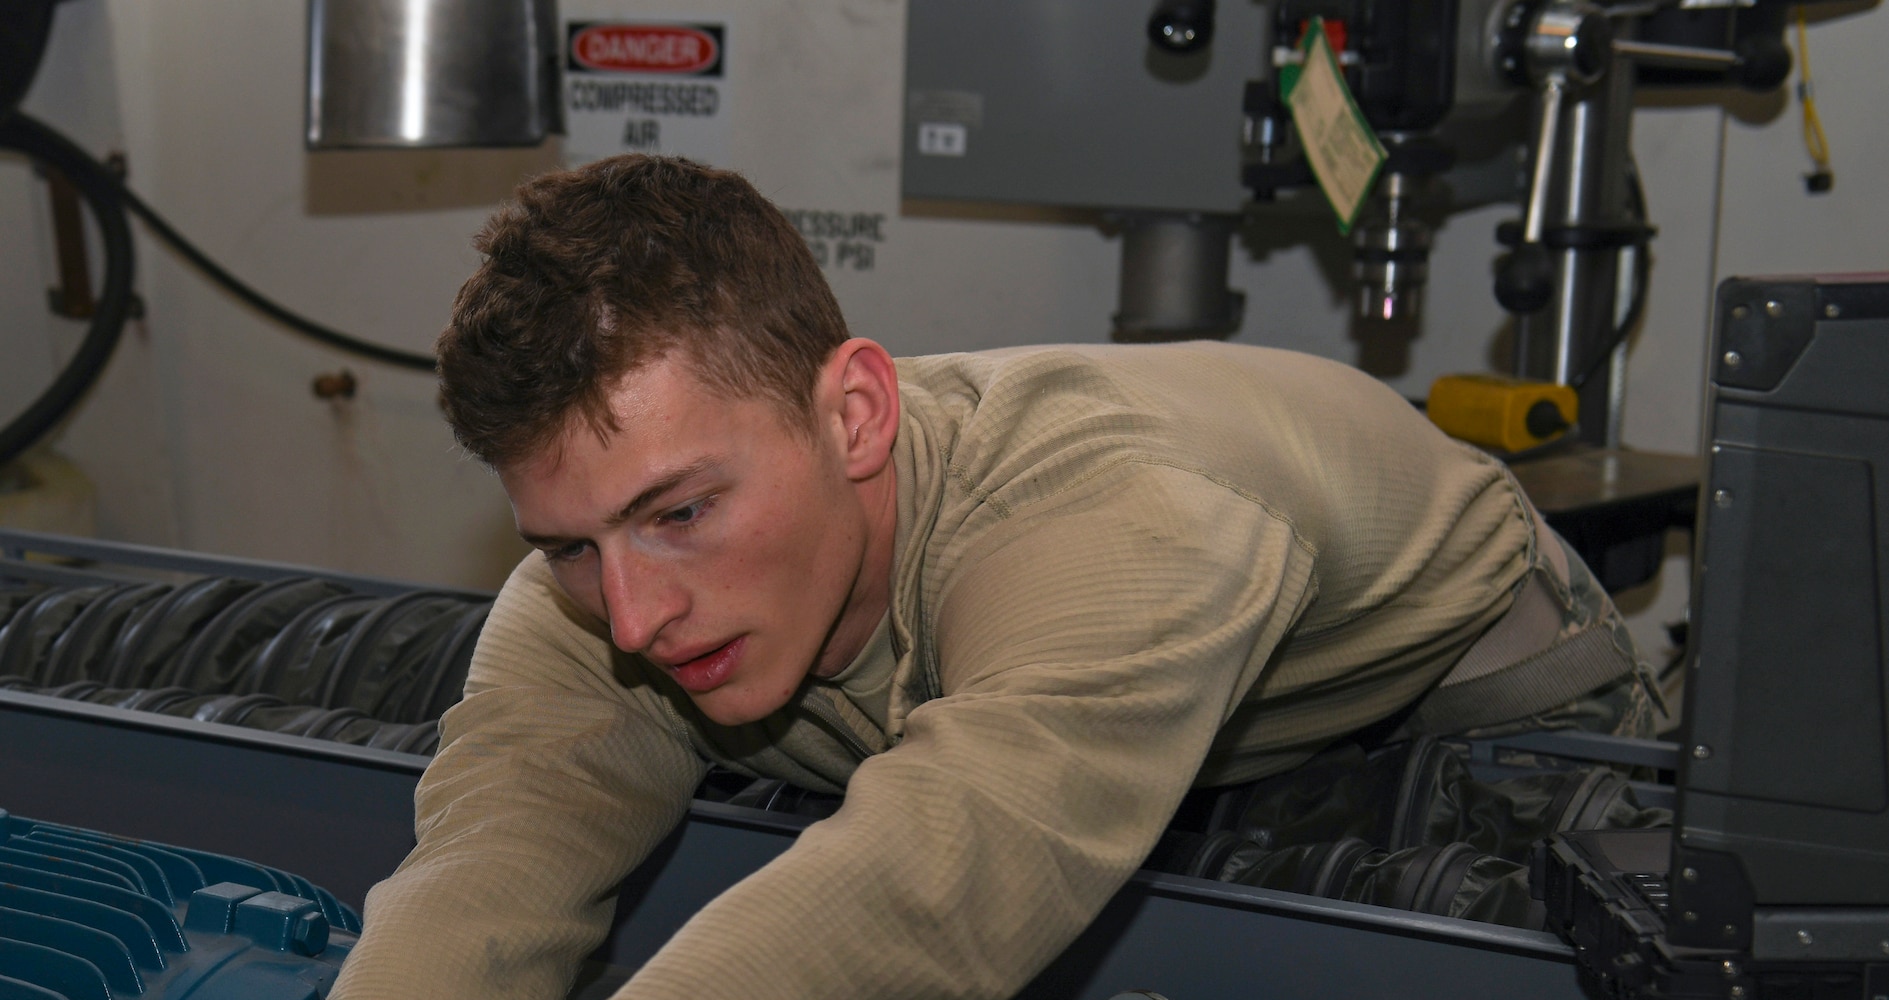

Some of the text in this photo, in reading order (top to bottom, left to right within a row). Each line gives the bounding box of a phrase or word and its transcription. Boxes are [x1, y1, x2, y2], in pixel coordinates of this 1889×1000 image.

[587, 33, 700, 65] DANGER
[570, 81, 720, 117] COMPRESSED
[623, 119, 661, 148] AIR
[835, 242, 876, 272] PSI
